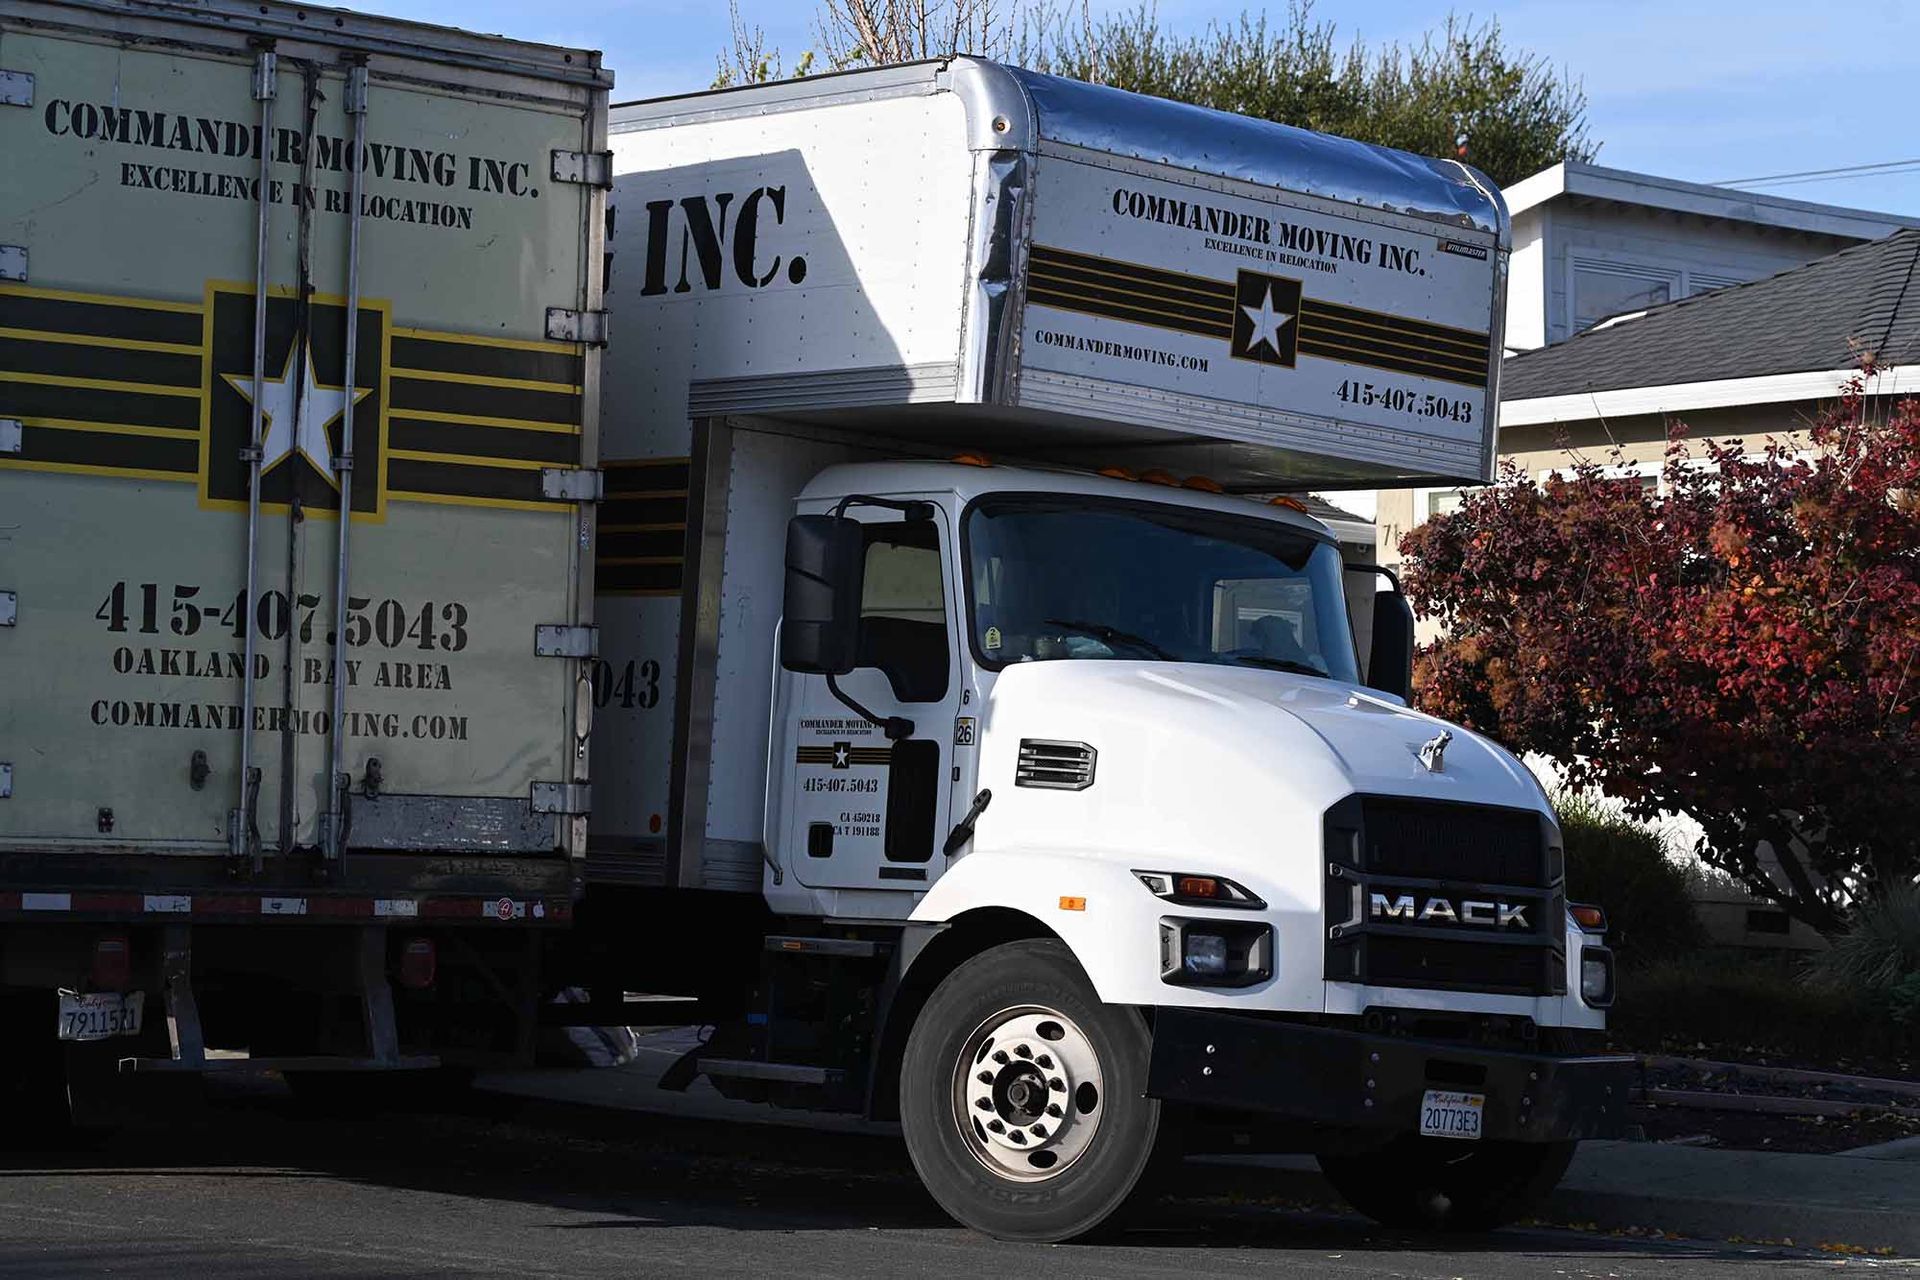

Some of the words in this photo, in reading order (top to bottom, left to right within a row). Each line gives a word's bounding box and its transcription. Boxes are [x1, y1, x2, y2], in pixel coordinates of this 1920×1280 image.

[45, 99, 304, 165] COMMANDER
[315, 135, 456, 187] MOVING
[468, 156, 539, 198] INC.
[120, 162, 284, 204] EXCELLENCE
[640, 185, 807, 297] INC.
[1112, 188, 1271, 245] COMMANDER
[1278, 222, 1372, 265] MOVING
[1378, 242, 1425, 276] INC.
[1204, 238, 1263, 259] EXCELLENCE
[1266, 250, 1277, 263] IN
[1279, 252, 1338, 274] RELOCATION
[1034, 329, 1209, 373] COMMANDERMOVING.COM
[1336, 379, 1472, 424] 415-407.5043
[96, 581, 468, 652] 415-407.5043
[113, 647, 270, 680] OAKLAND
[303, 658, 361, 686] BAY
[374, 662, 452, 690] AREA
[963, 689, 970, 705] 6
[91, 700, 469, 741] COMMANDERMOING.COM
[800, 719, 843, 729] COMMANDER
[957, 725, 972, 743] 26
[803, 778, 878, 793] 415-407.5043
[840, 812, 850, 823] CA
[852, 812, 881, 823] 450218
[845, 826, 850, 836] T
[1369, 892, 1530, 928] MACK
[1425, 1107, 1479, 1132] 20773E3
